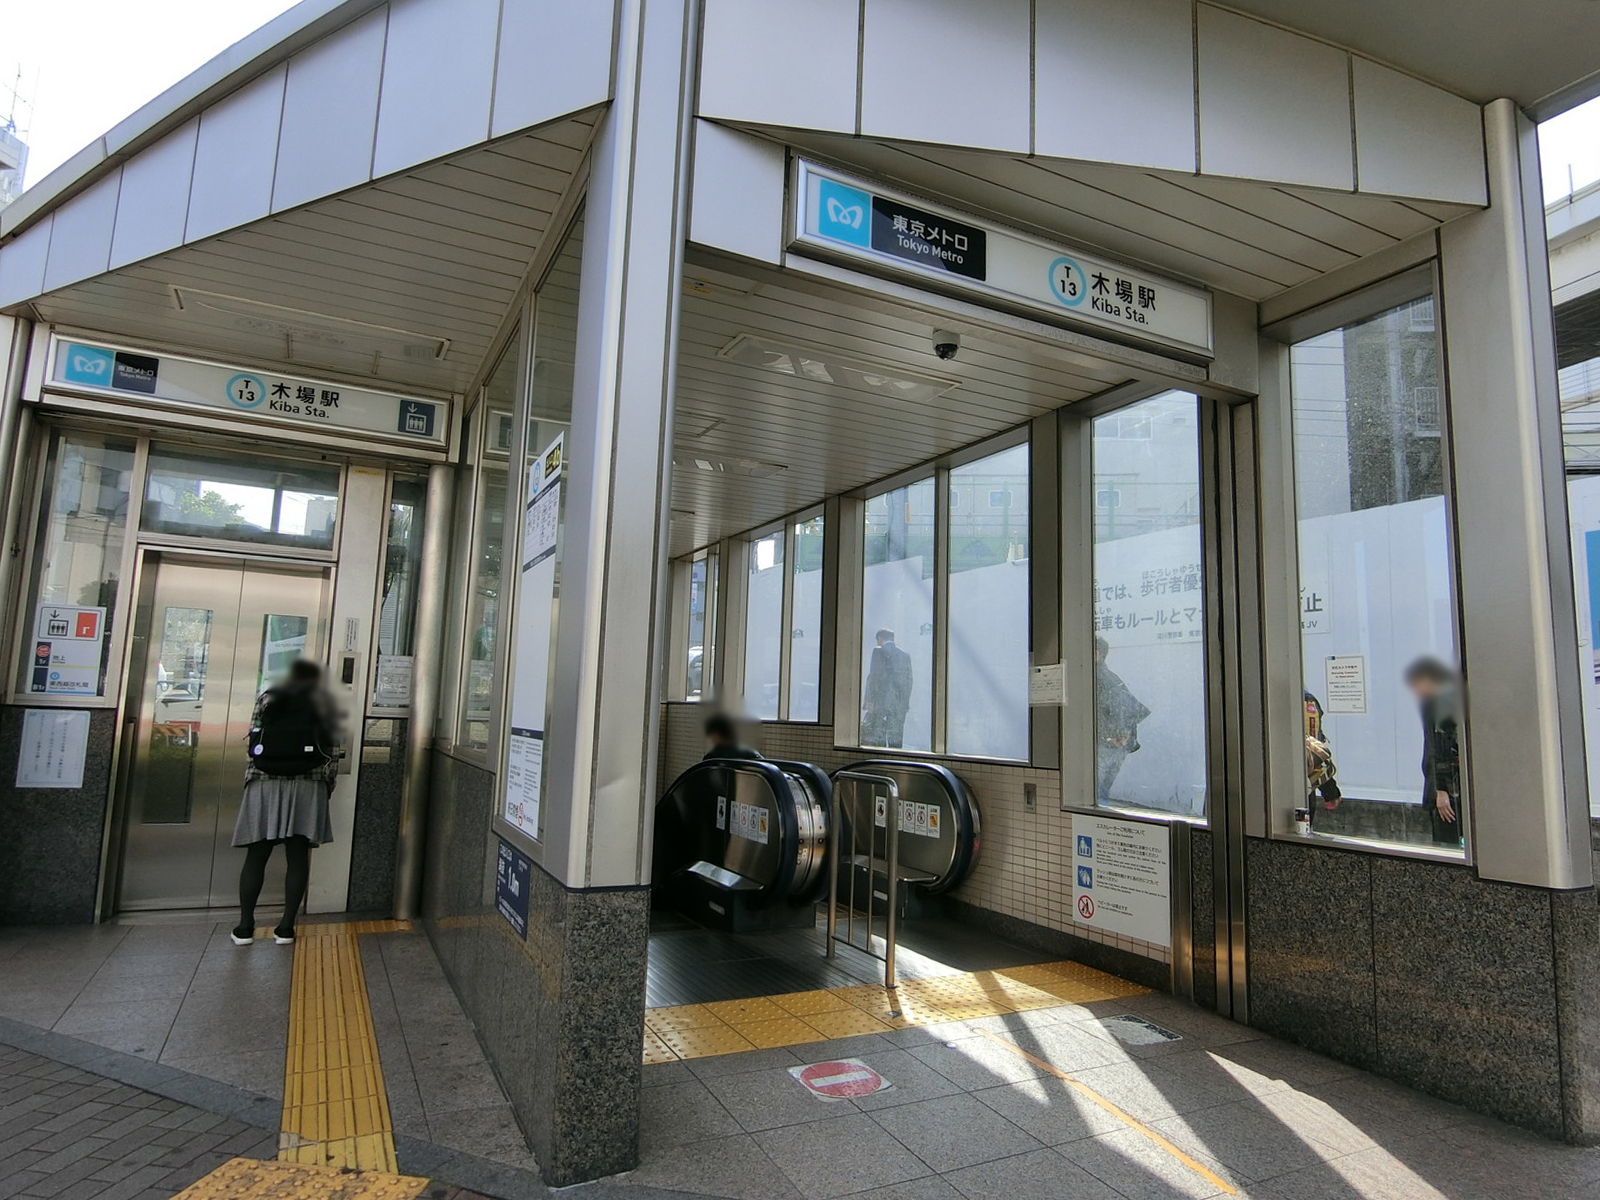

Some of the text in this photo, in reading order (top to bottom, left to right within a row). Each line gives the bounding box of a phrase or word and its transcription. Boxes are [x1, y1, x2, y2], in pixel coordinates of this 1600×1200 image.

[892, 214, 968, 251] 東京メトロ
[897, 234, 964, 264] Tokyo Metro
[1064, 265, 1072, 279] T
[1060, 279, 1077, 297] 13
[1091, 271, 1156, 311] 木場駅
[1091, 296, 1149, 325] Kiba Sta.
[238, 389, 256, 402] 13
[243, 379, 252, 390] T
[271, 382, 340, 409] 木場駅
[269, 399, 330, 419] Kiba Sta.
[1300, 592, 1323, 613] 止
[1095, 605, 1202, 632] 車もルールとマ
